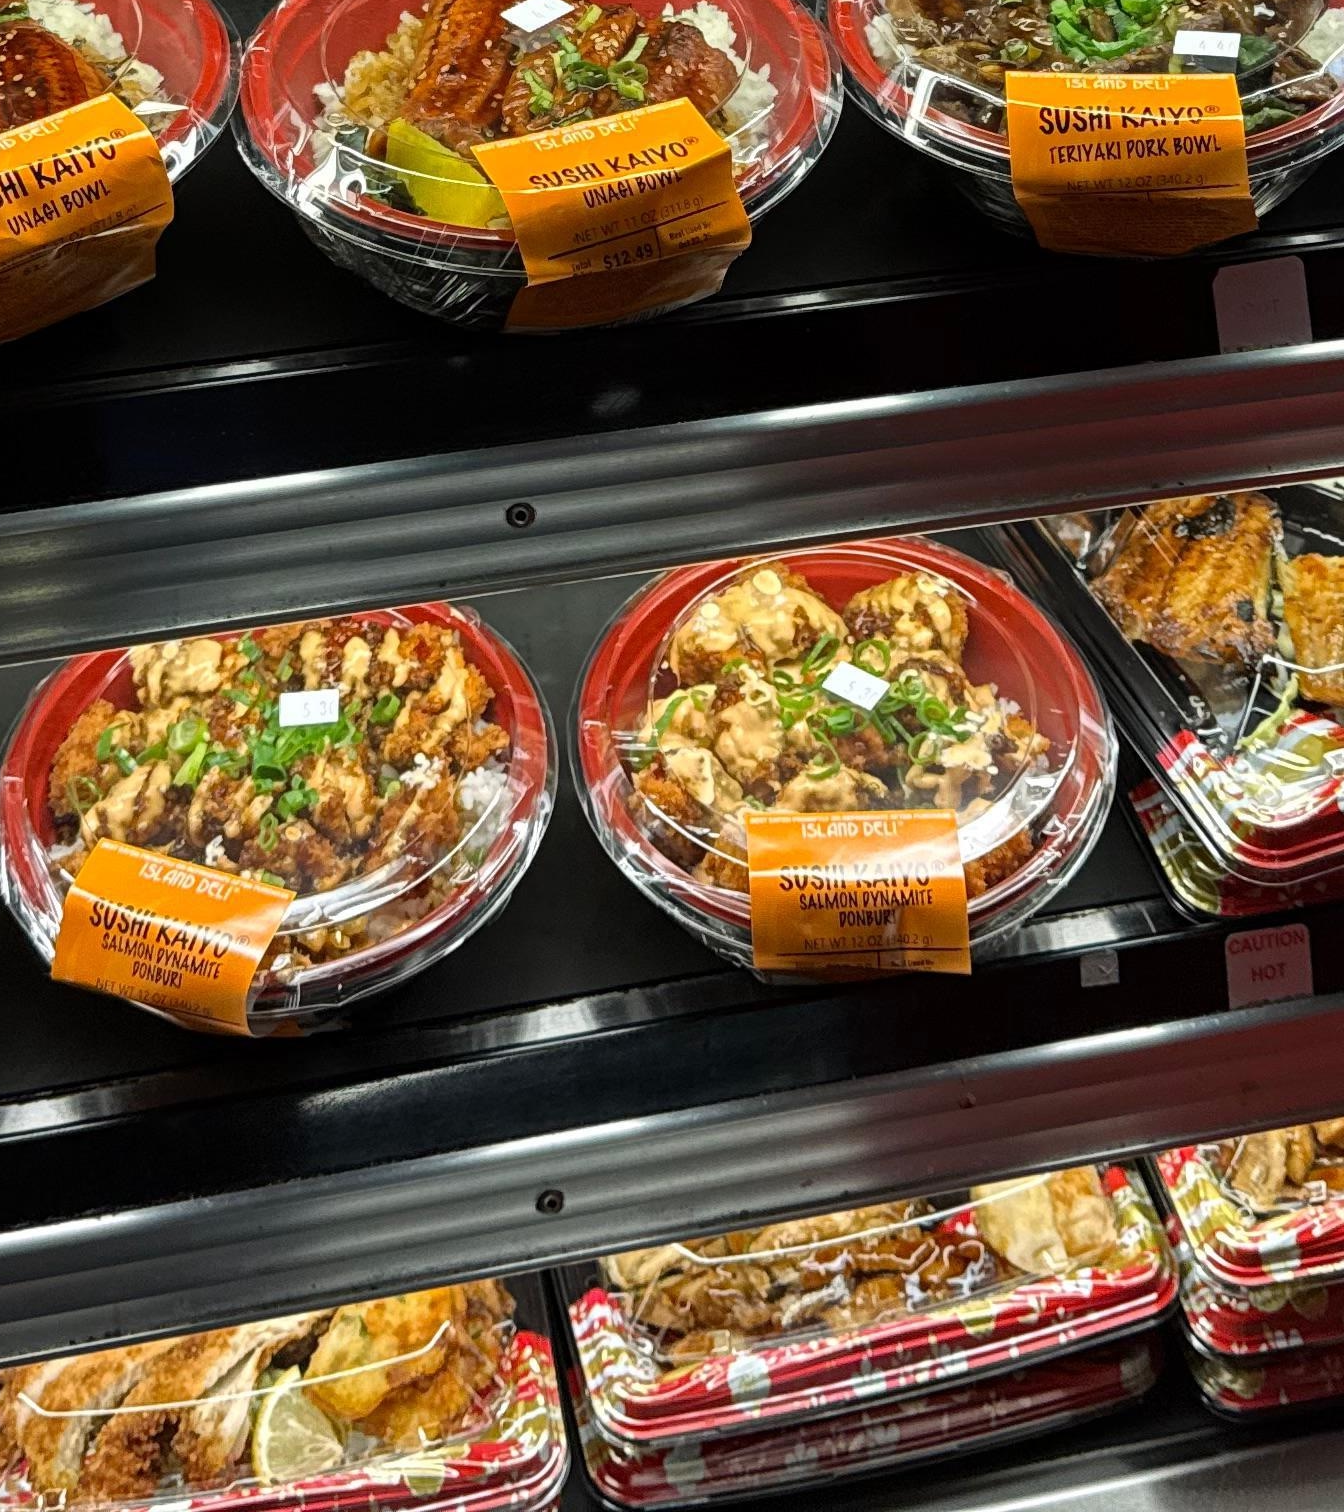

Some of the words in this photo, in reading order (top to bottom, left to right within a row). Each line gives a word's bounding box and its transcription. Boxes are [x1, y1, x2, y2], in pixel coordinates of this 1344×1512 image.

[1049, 141, 1122, 166] TERIYAKI
[1127, 137, 1170, 160] PORK
[1174, 133, 1222, 156] BOWL
[583, 180, 634, 210] UNAGI
[638, 167, 683, 196] BOWL
[6, 200, 59, 237] UNAGI
[64, 178, 111, 215] BOWL
[574, 227, 598, 245] NET
[600, 222, 622, 240] WT
[603, 243, 655, 270] $12.49
[799, 890, 859, 911] SALMON
[862, 888, 934, 909] DYNAMITE
[838, 909, 897, 928] DONBURI
[1228, 928, 1307, 956] CAUTION
[101, 932, 155, 963] SALMON
[156, 949, 224, 981] DYNAMITE
[132, 960, 184, 990] DONBURI
[1250, 962, 1287, 983] HOT
